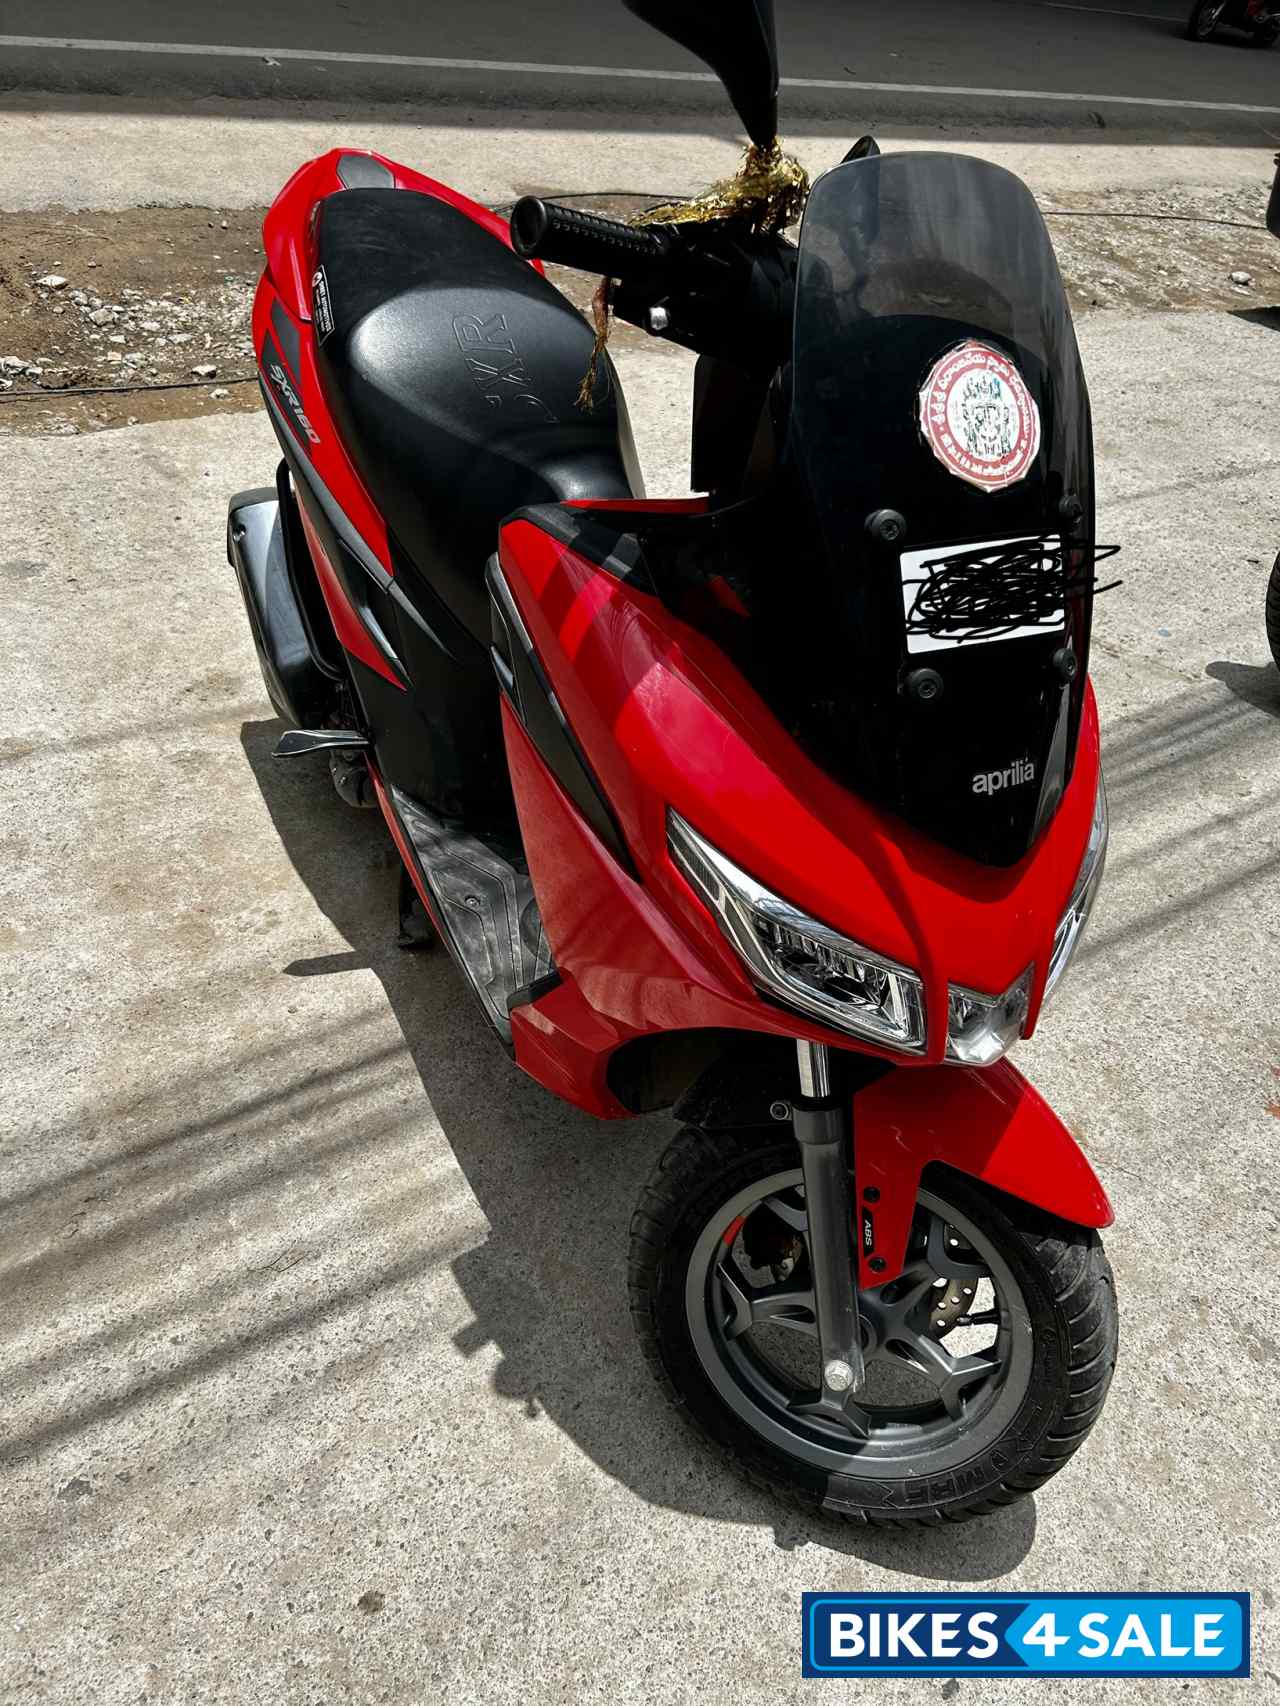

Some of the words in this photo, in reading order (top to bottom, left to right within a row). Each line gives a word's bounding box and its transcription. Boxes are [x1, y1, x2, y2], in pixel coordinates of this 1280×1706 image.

[270, 363, 321, 444] SXR160
[972, 760, 1035, 796] aprilia
[864, 1219, 873, 1247] ABS
